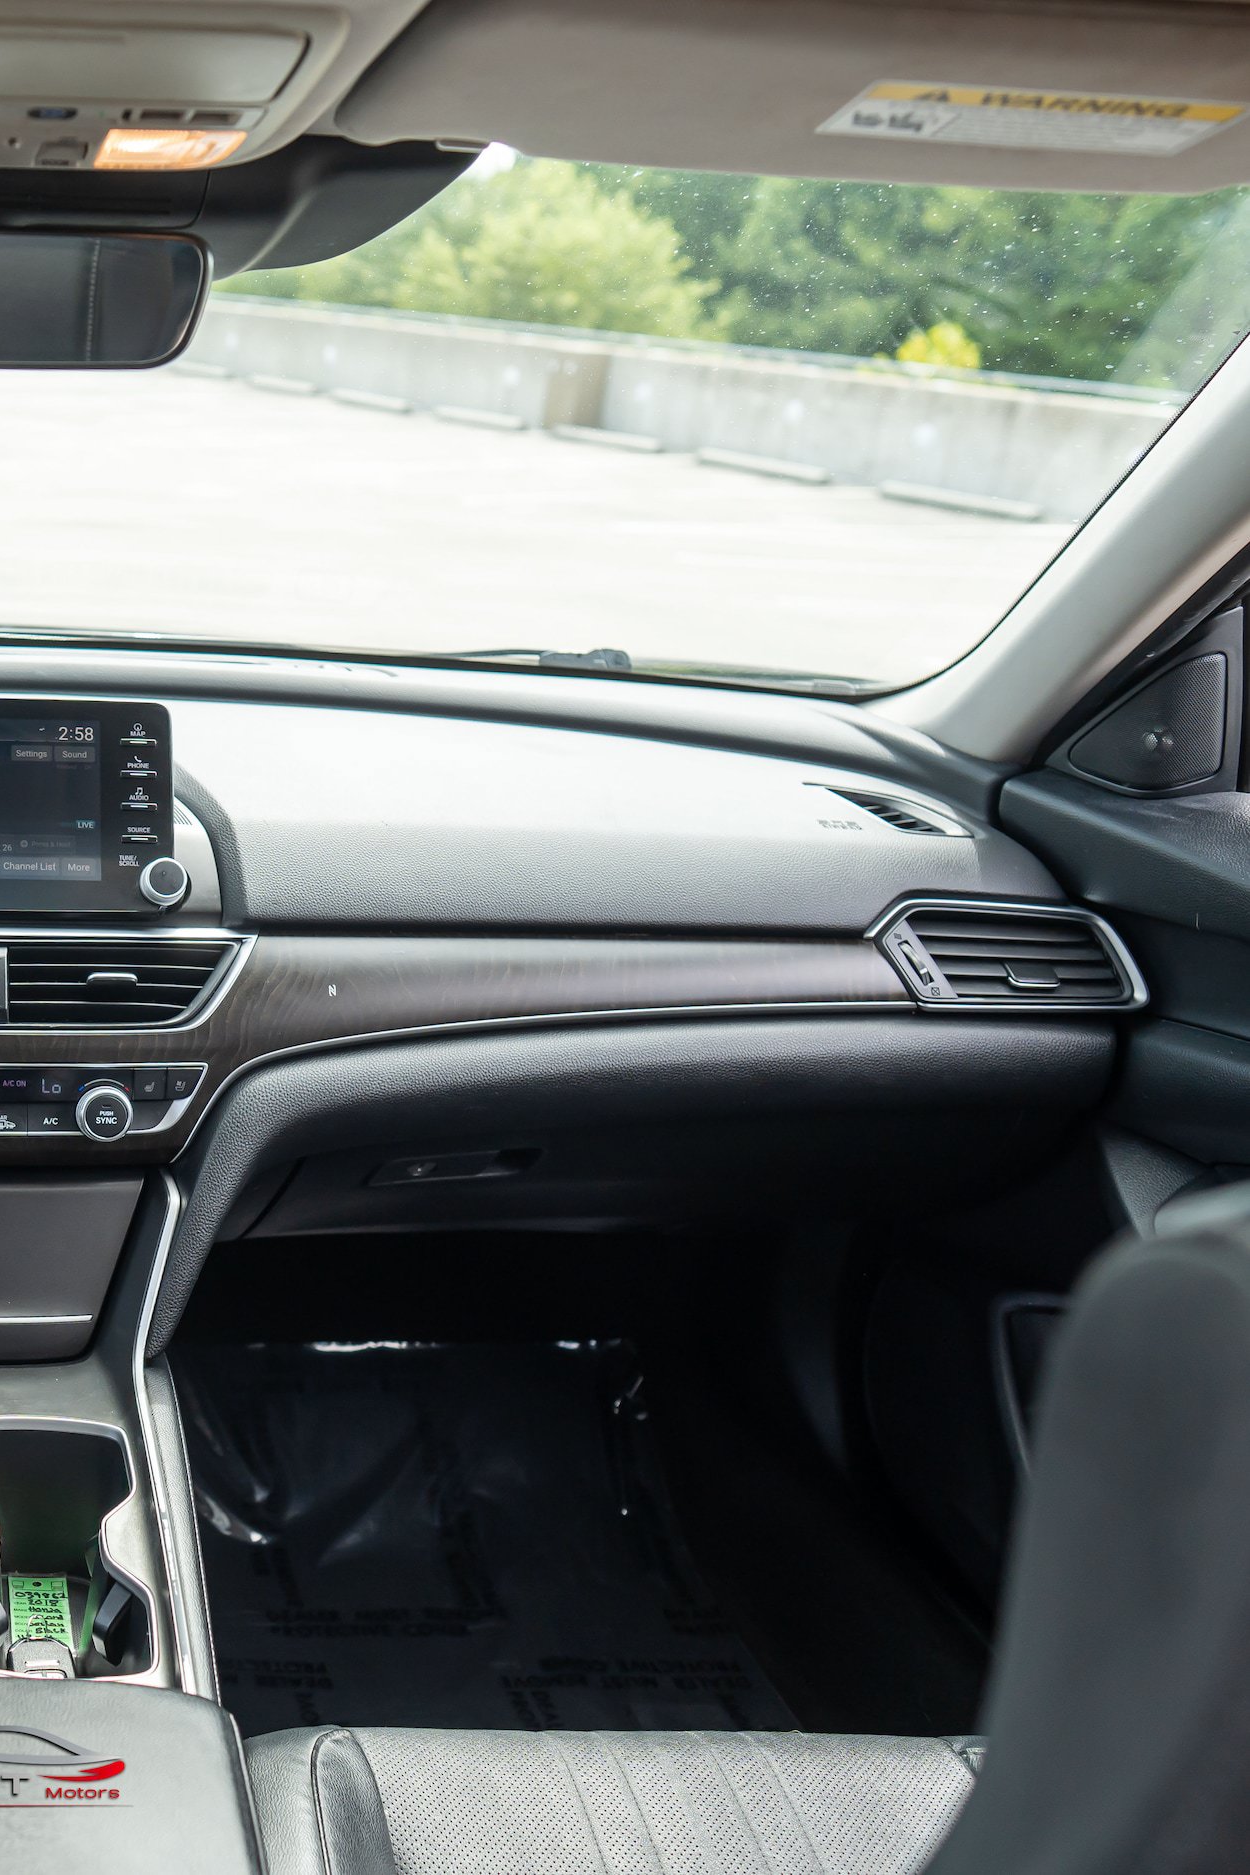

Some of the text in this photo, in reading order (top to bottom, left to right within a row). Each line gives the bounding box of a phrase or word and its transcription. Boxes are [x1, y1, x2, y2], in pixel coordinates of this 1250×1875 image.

[980, 92, 1190, 118] WARNING
[58, 726, 94, 741] 2:58
[15, 750, 48, 759] Settings
[62, 751, 88, 759] Sound
[77, 821, 95, 829] LIVE
[2, 844, 13, 852] 26
[3, 862, 57, 872] Channel List
[67, 864, 91, 872] More
[2, 1079, 15, 1087] A/C
[43, 1117, 59, 1126] A/C
[96, 1116, 118, 1125] SYNC
